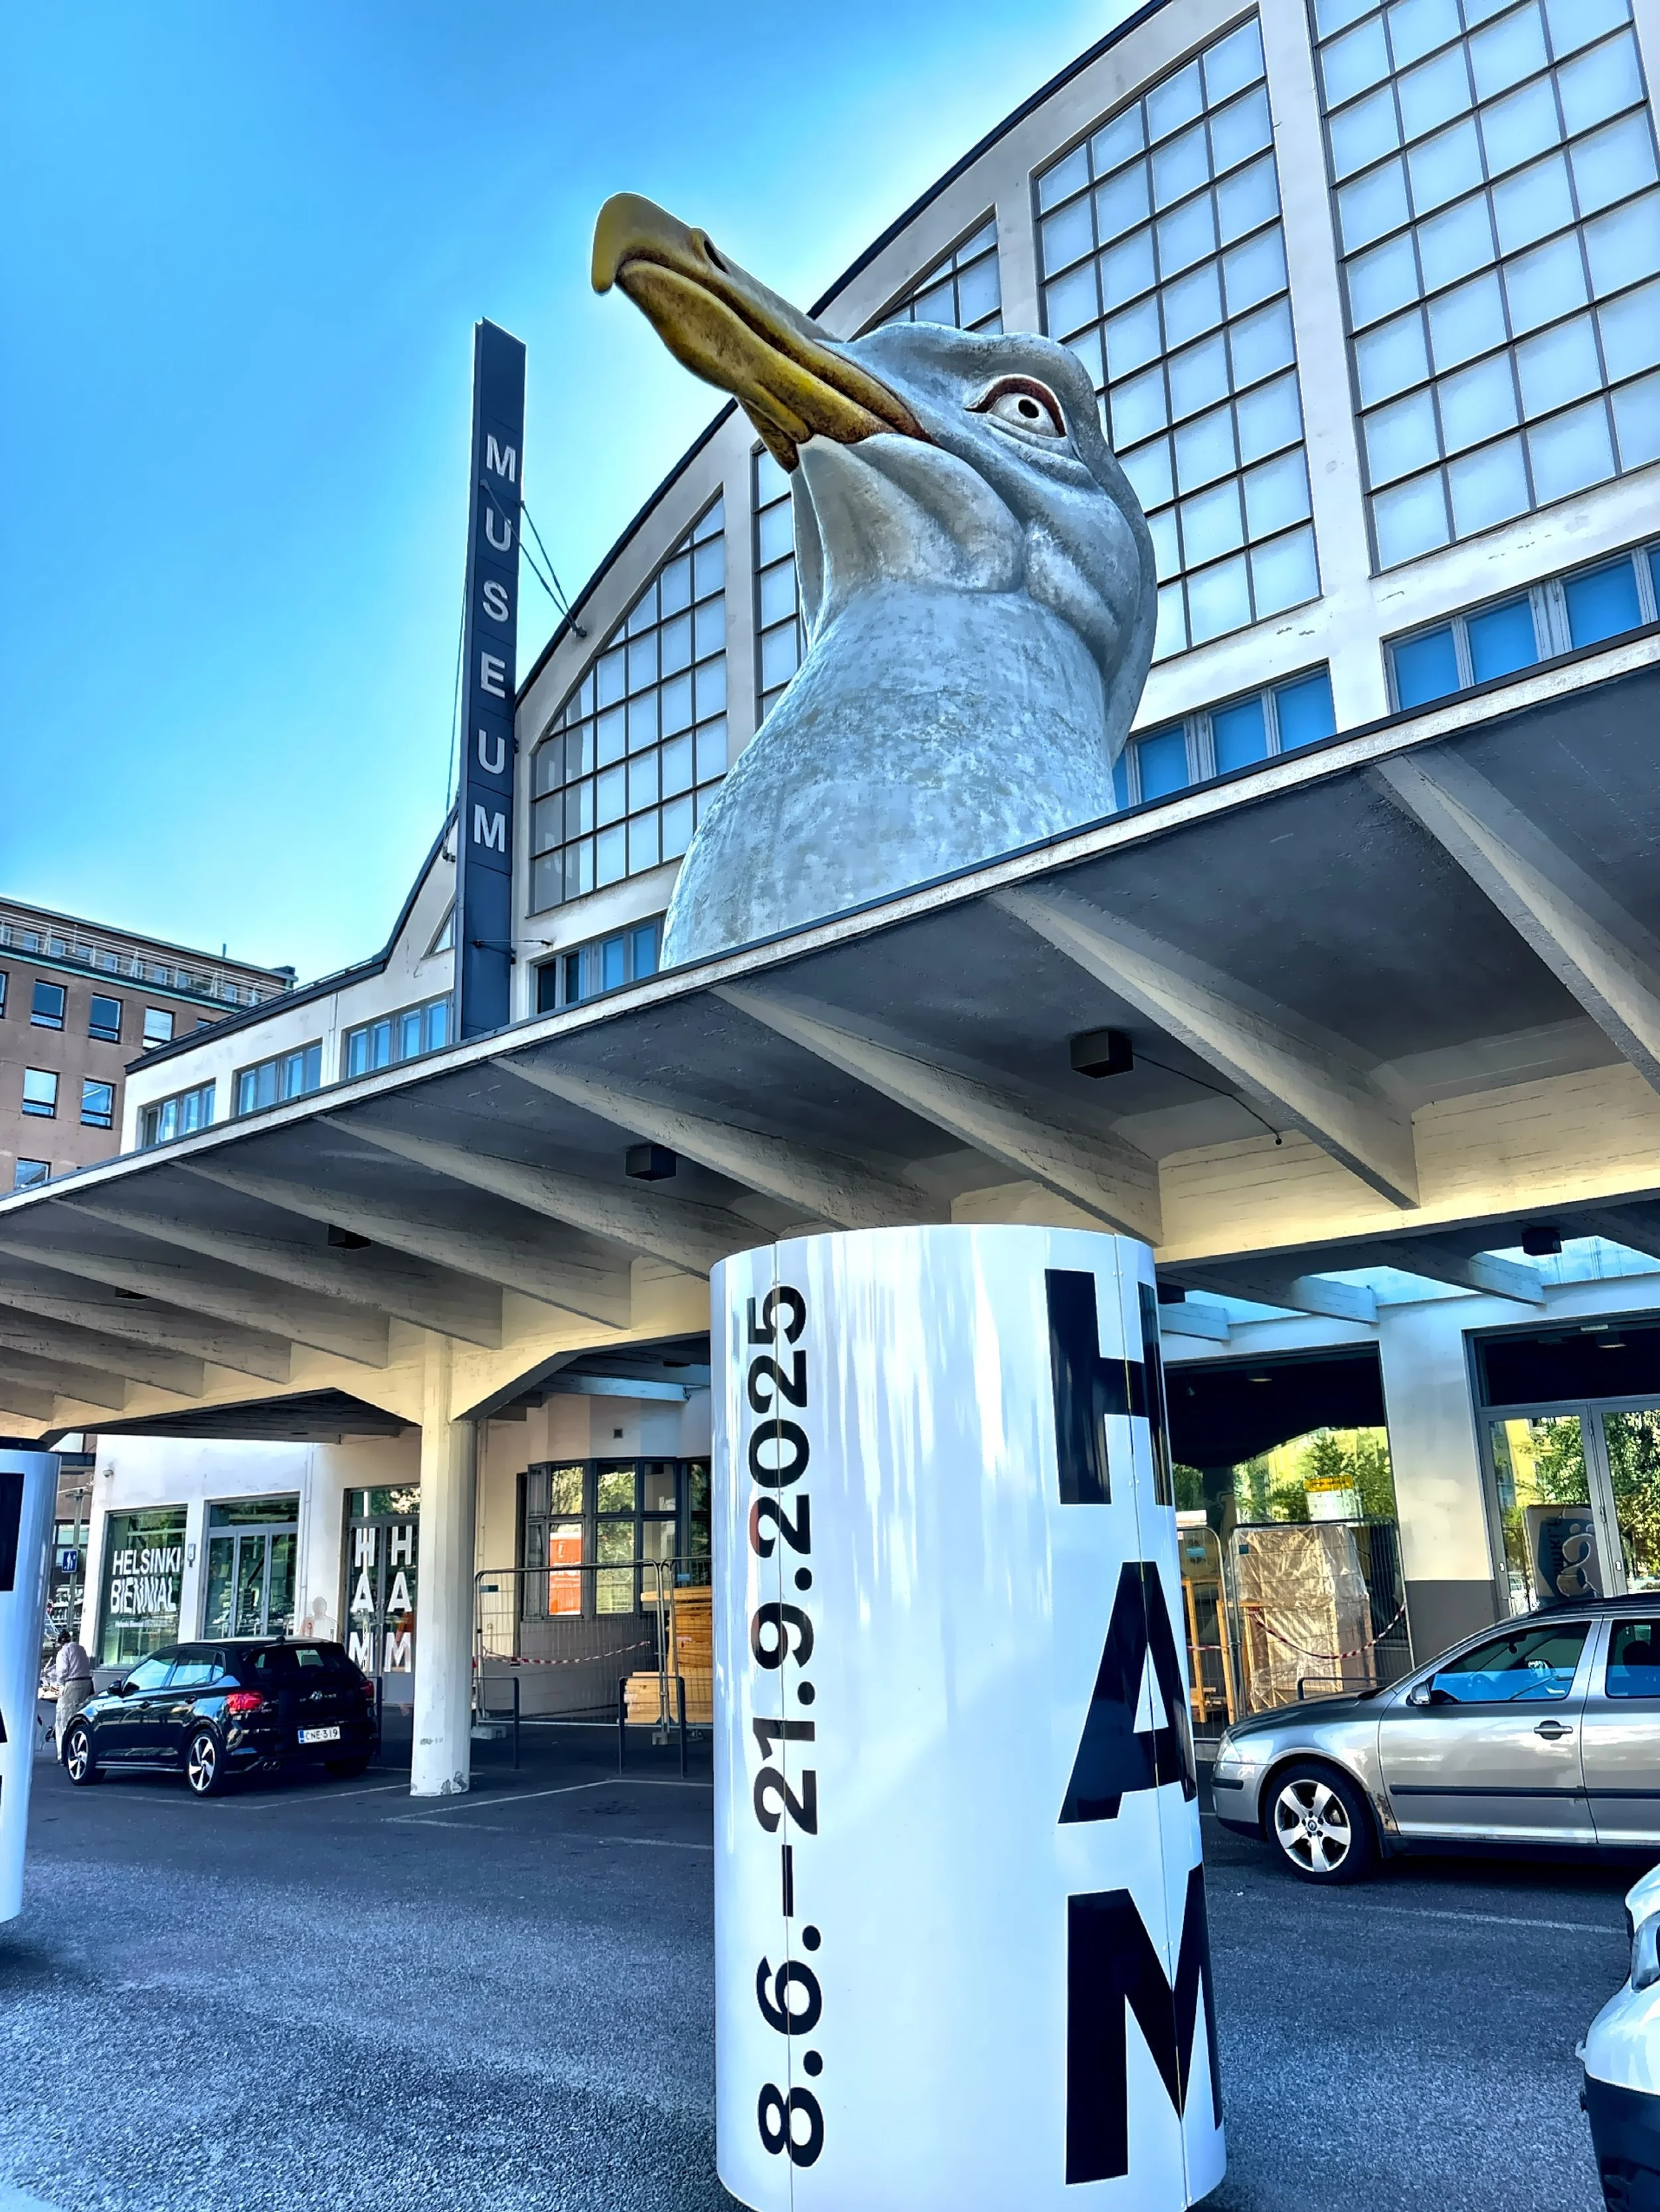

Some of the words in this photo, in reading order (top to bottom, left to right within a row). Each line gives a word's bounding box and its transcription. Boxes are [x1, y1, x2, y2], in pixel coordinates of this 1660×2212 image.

[473, 434, 516, 853] MUSEUM
[110, 1576, 177, 1614] BIENNIAL
[112, 1546, 181, 1575] HELSINKI
[349, 1528, 376, 1672] HAM
[384, 1526, 413, 1672] HAM
[1046, 1269, 1220, 2185] HAM
